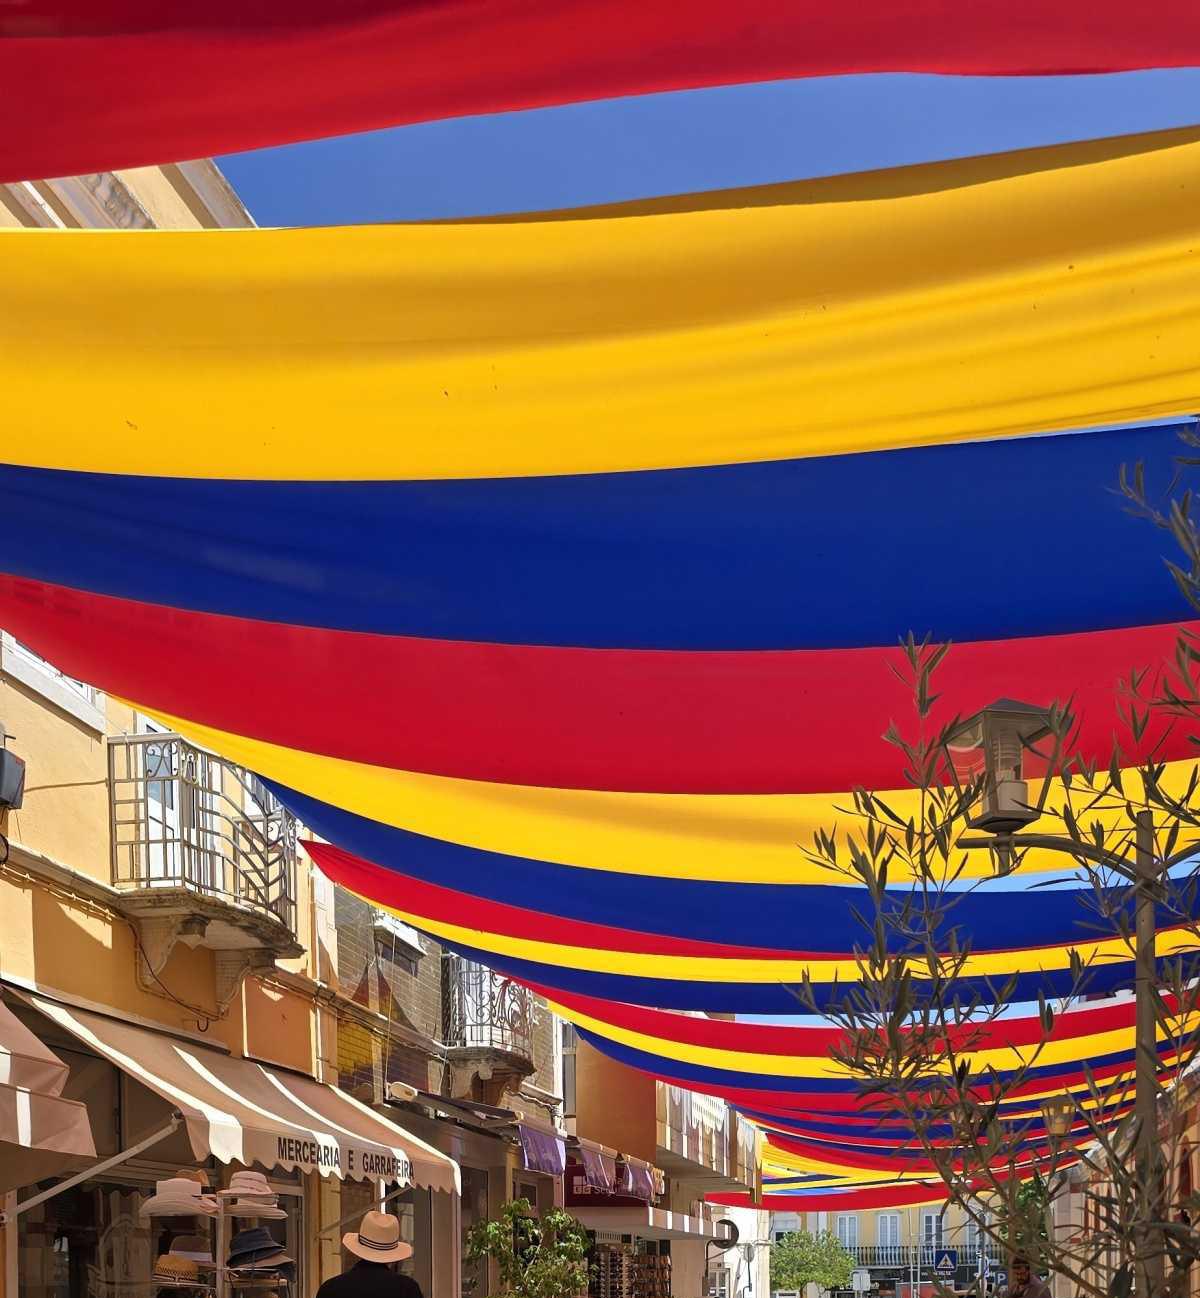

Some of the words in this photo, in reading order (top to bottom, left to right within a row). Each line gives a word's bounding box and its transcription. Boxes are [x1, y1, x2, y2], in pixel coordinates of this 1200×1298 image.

[277, 1136, 341, 1168] MERCEARIA
[348, 1150, 354, 1170] E
[362, 1152, 415, 1180] GARRAFEIRA
